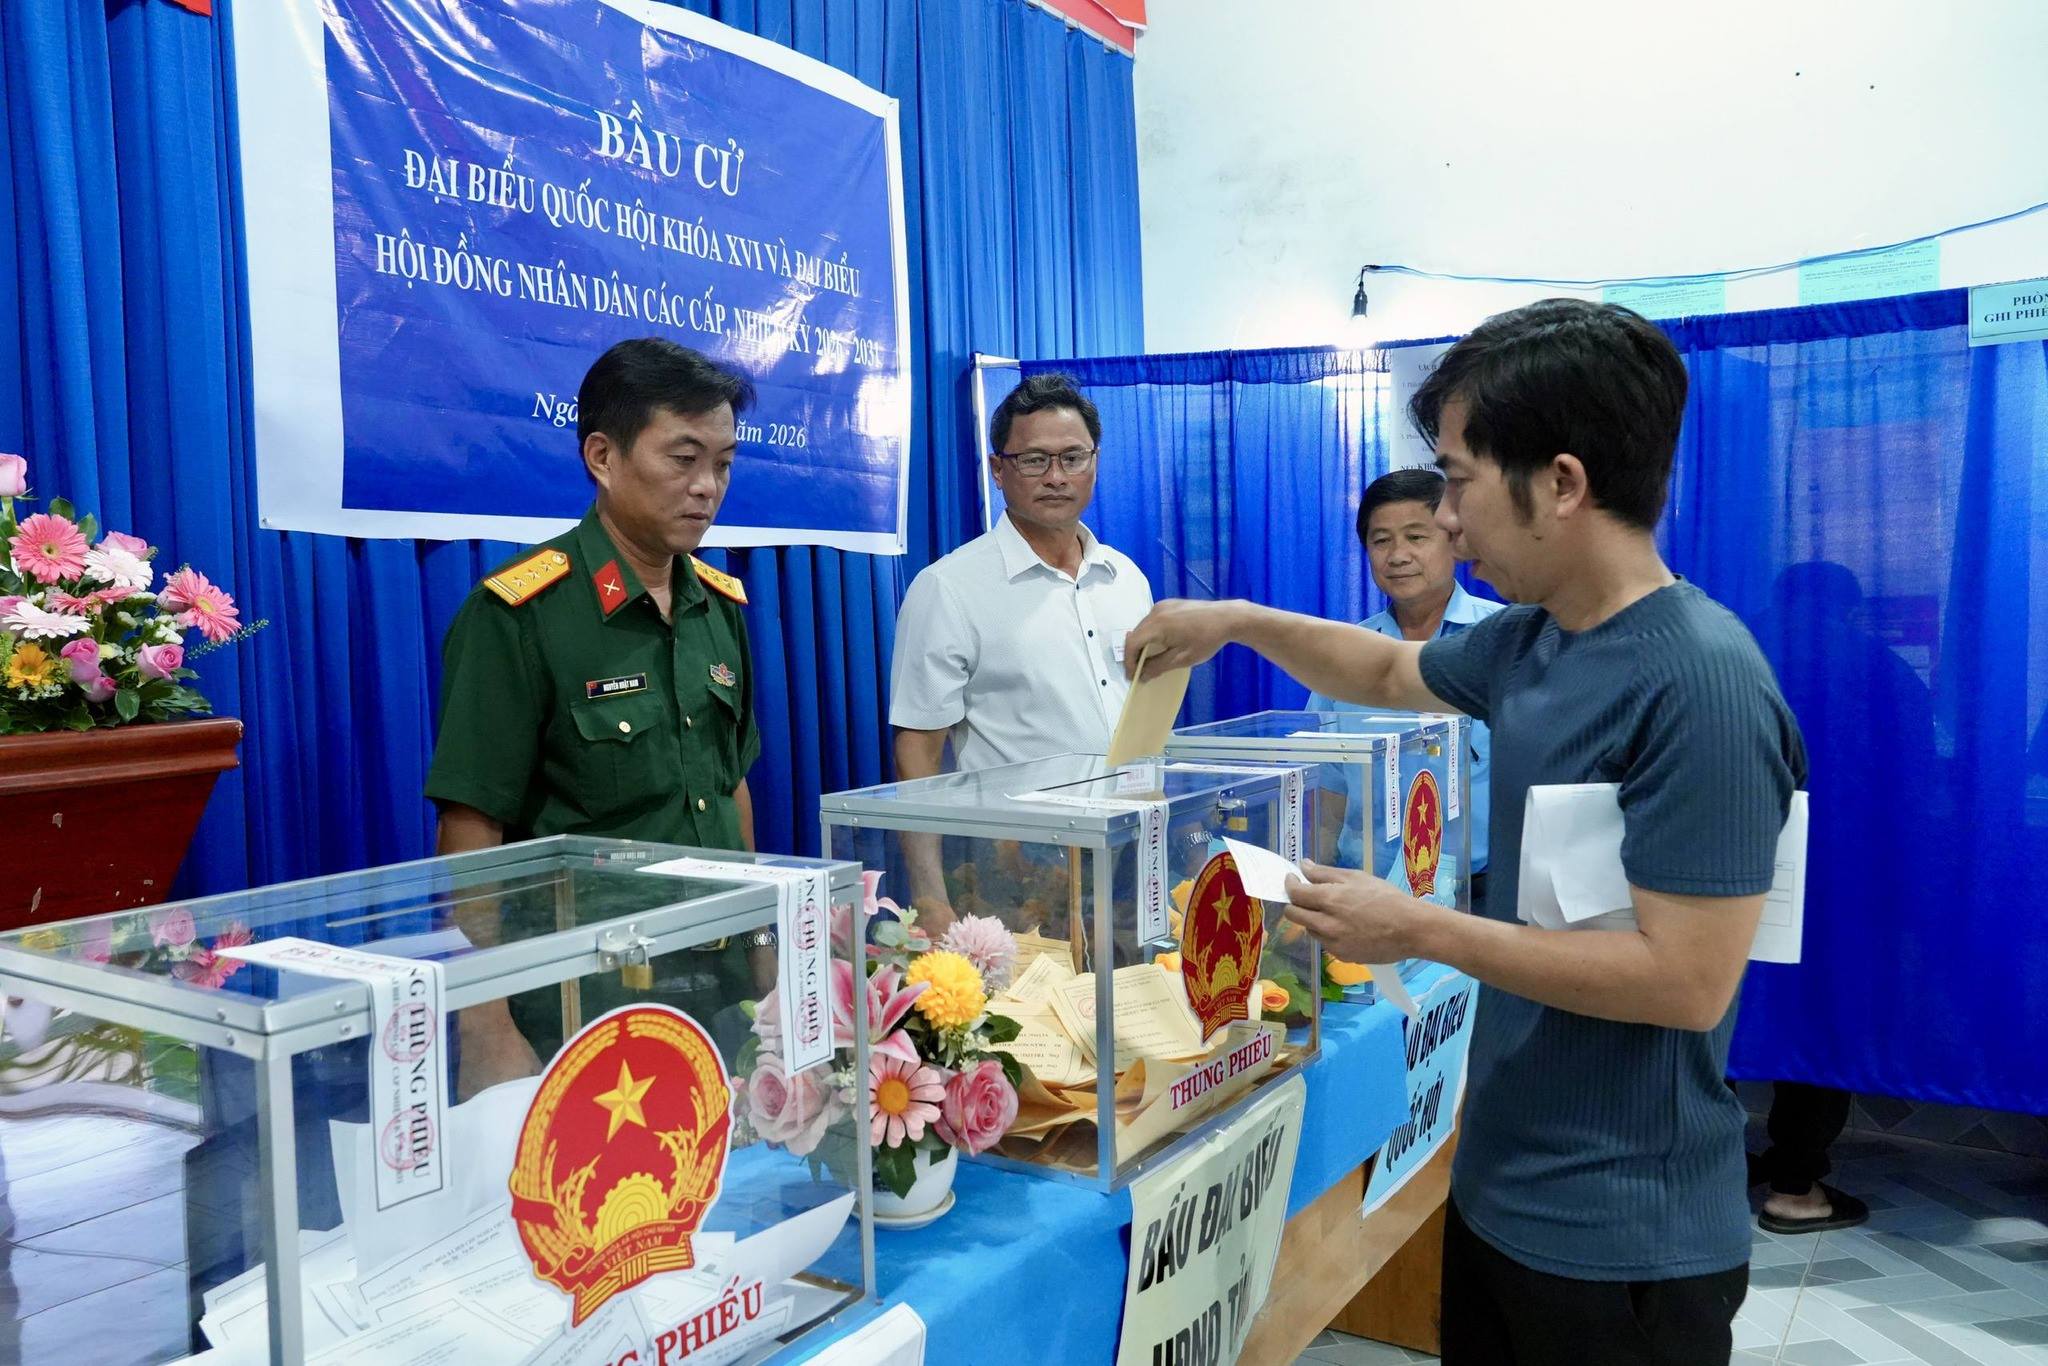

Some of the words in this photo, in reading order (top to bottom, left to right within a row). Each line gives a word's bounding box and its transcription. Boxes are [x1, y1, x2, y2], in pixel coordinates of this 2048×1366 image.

[594, 100, 681, 177] BẦU
[694, 138, 744, 196] CỬ
[404, 149, 460, 204] ĐẠI
[467, 153, 535, 213] BIỂU
[542, 178, 610, 232] QUỐC
[615, 198, 658, 251] HỘI
[661, 216, 723, 262] KHÓA
[725, 234, 764, 271] XVI
[764, 237, 791, 278] VÀ
[823, 251, 860, 297] BIỂU
[375, 228, 429, 289] HỘI
[432, 232, 513, 297] ĐỒNG
[517, 259, 587, 311] NHÂN
[592, 270, 638, 319] DÂN
[643, 281, 685, 328] CÁC
[1984, 311, 2010, 323] GHI
[532, 392, 579, 427] Ngà
[735, 421, 762, 443] ăm
[768, 423, 807, 448] 2026
[1170, 1062, 1224, 1110] THÙNG
[1229, 1025, 1271, 1077] PHIẾU
[1419, 1070, 1445, 1142] HỘI
[636, 1235, 663, 1252] NAM
[1137, 1181, 1198, 1294] BẦU
[1198, 1164, 1240, 1254] ĐẠI
[1240, 1106, 1285, 1221] BIỂU
[655, 1275, 763, 1366] PHIẾU
